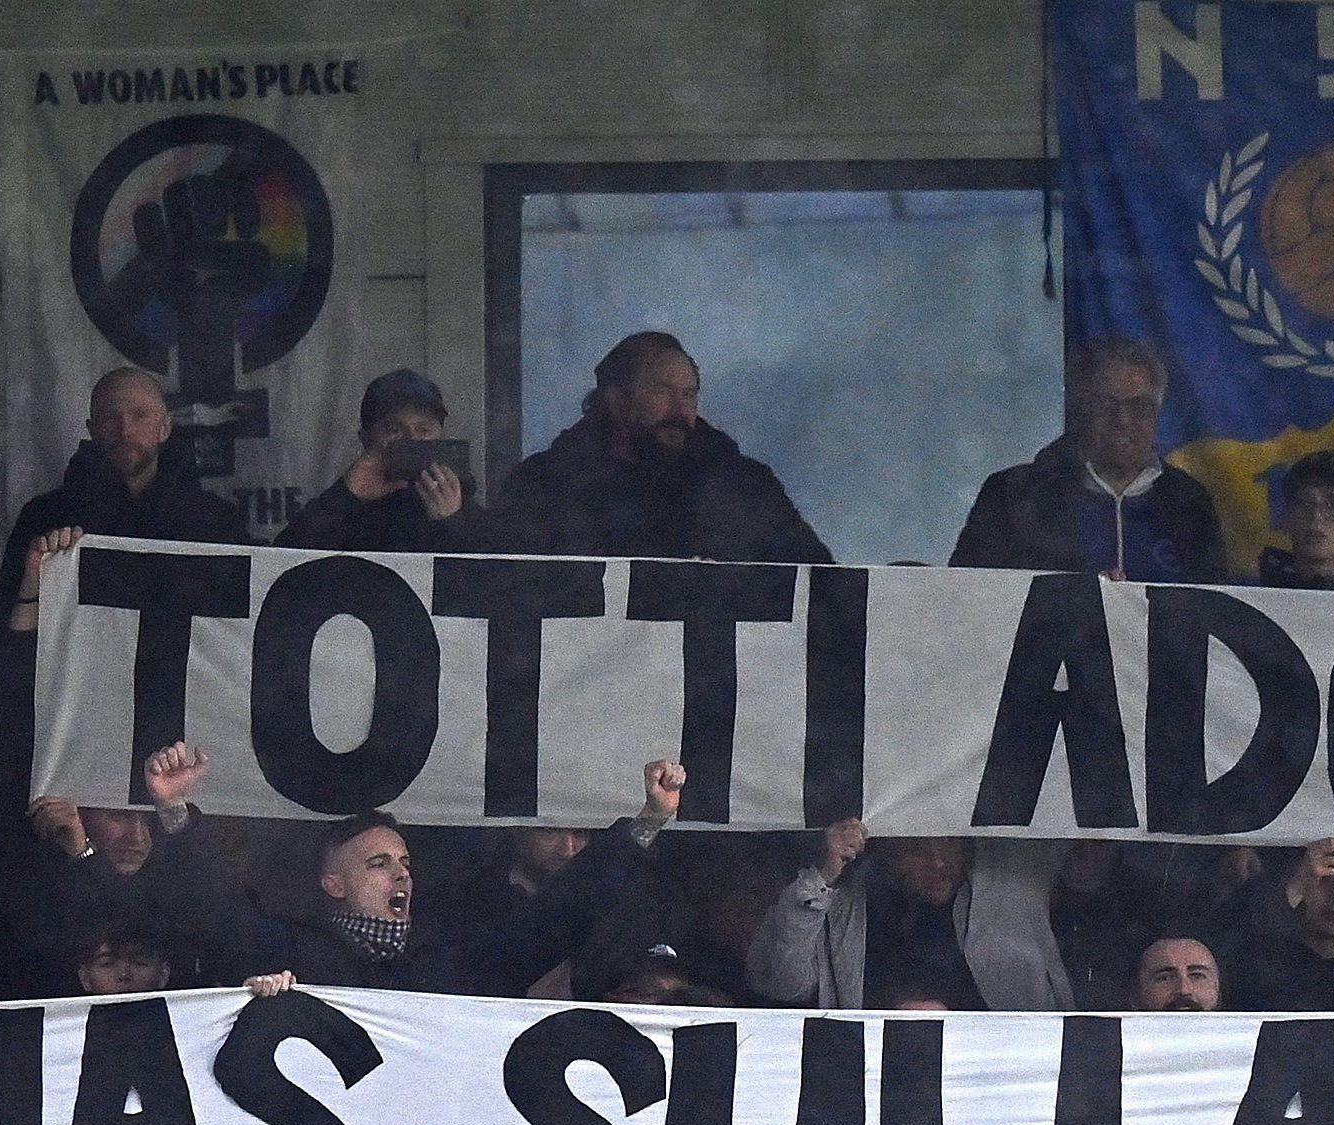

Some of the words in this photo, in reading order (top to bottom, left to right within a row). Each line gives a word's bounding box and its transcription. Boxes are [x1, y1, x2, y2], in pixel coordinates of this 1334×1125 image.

[34, 71, 60, 104] A
[72, 60, 248, 104] WOMAN'S
[254, 60, 359, 100] PLACE
[79, 548, 868, 828] TOTTI
